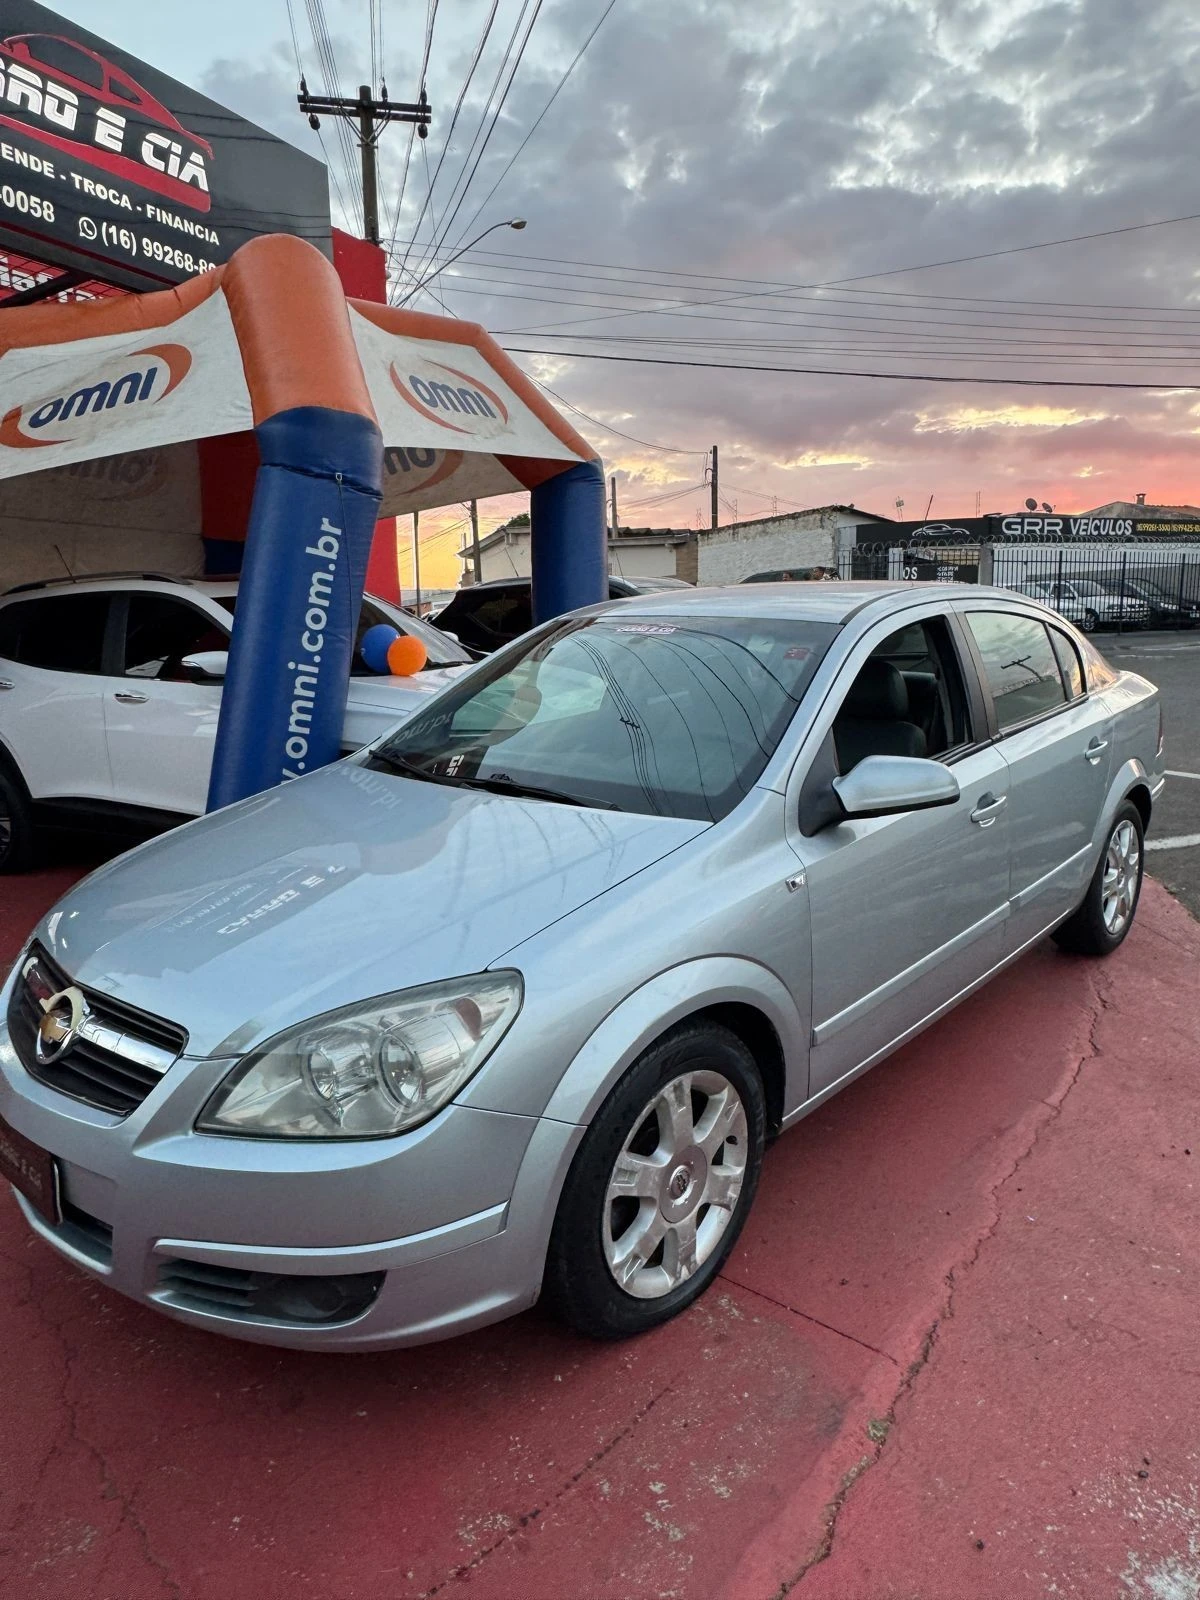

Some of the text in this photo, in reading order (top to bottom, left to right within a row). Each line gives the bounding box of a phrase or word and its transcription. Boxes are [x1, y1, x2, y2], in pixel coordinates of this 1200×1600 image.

[95, 107, 126, 152] E
[142, 133, 209, 192] CIA
[70, 172, 132, 211] TROCA
[147, 204, 220, 246] FINANCIA
[102, 222, 137, 256] (16)
[1002, 518, 1063, 536] GRR
[1069, 517, 1133, 536] VEÍCULOS
